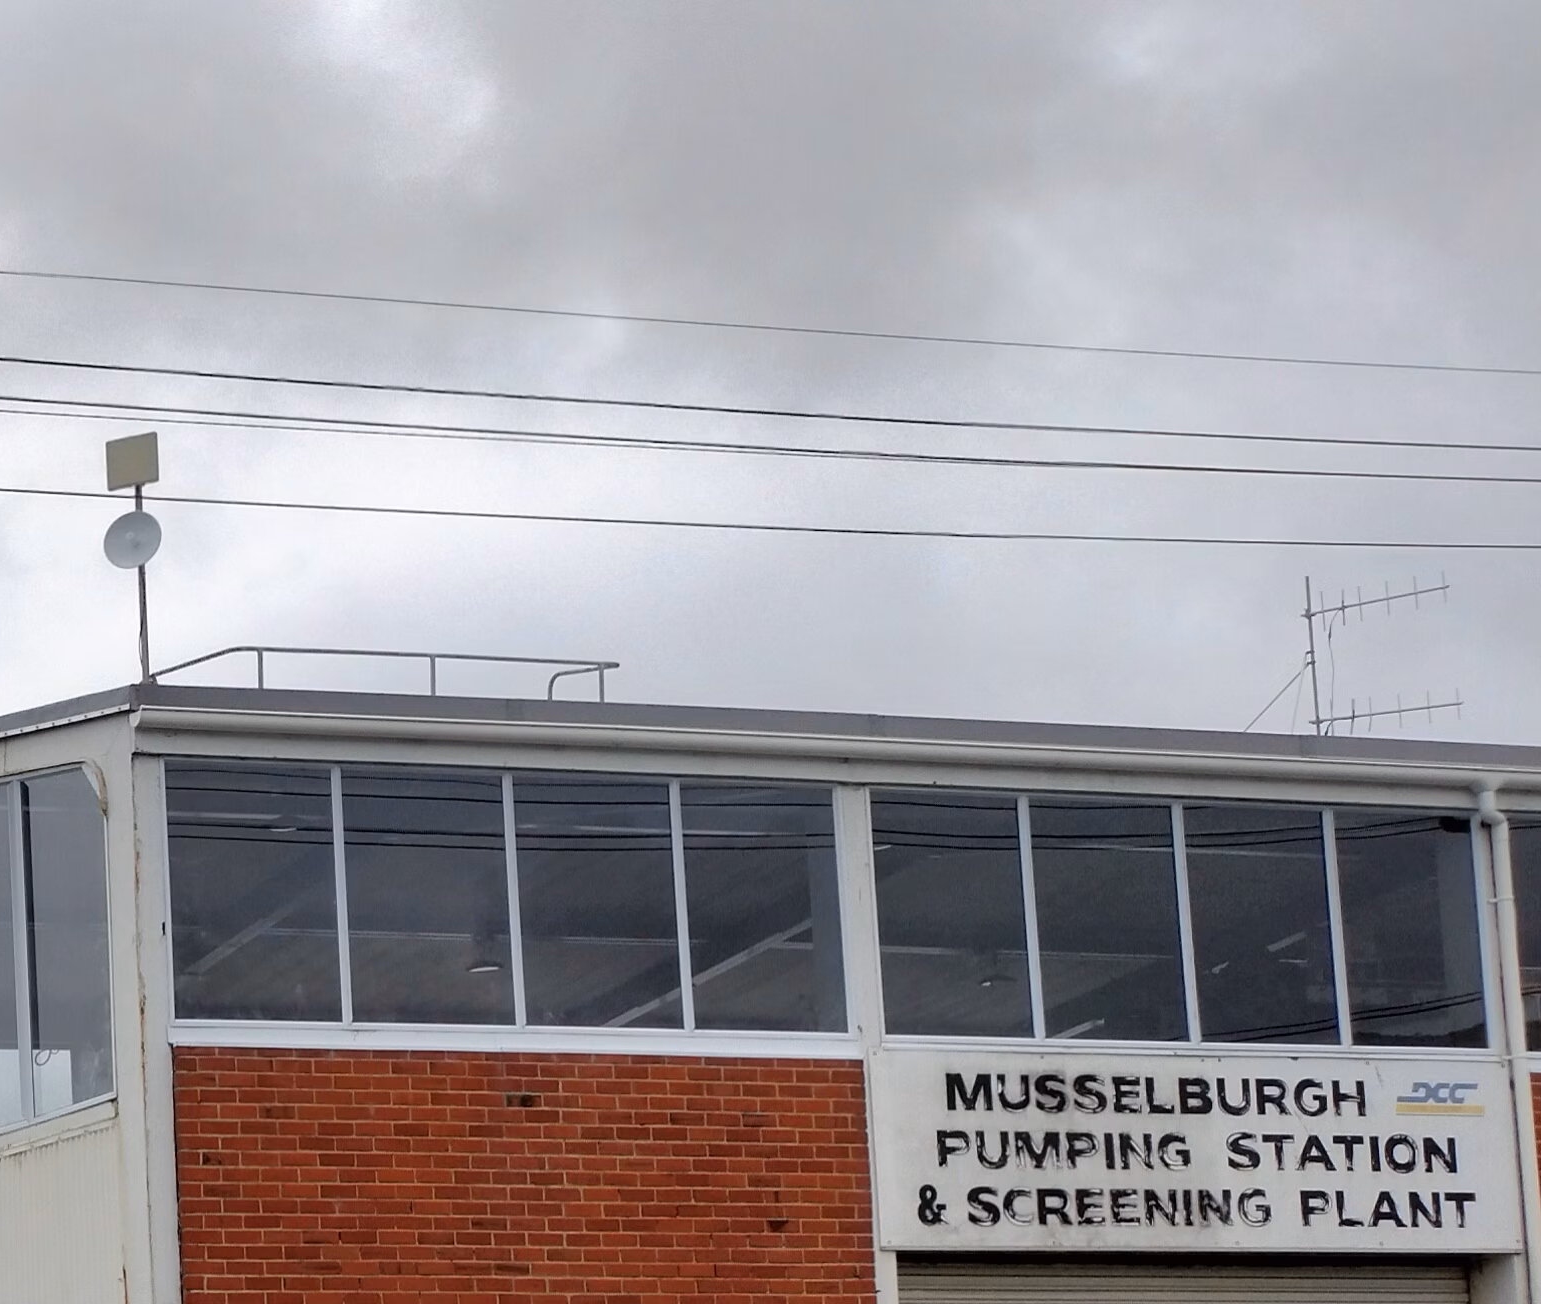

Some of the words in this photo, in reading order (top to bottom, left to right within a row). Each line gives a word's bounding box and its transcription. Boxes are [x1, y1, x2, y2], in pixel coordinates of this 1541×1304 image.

[945, 1072, 1366, 1117] MUSSELBURGH
[936, 1129, 1191, 1170] PUMPING
[1226, 1131, 1458, 1174] STATION
[918, 1184, 949, 1227] &
[967, 1186, 1272, 1228] SCREENING
[1299, 1189, 1476, 1229] PLANT
